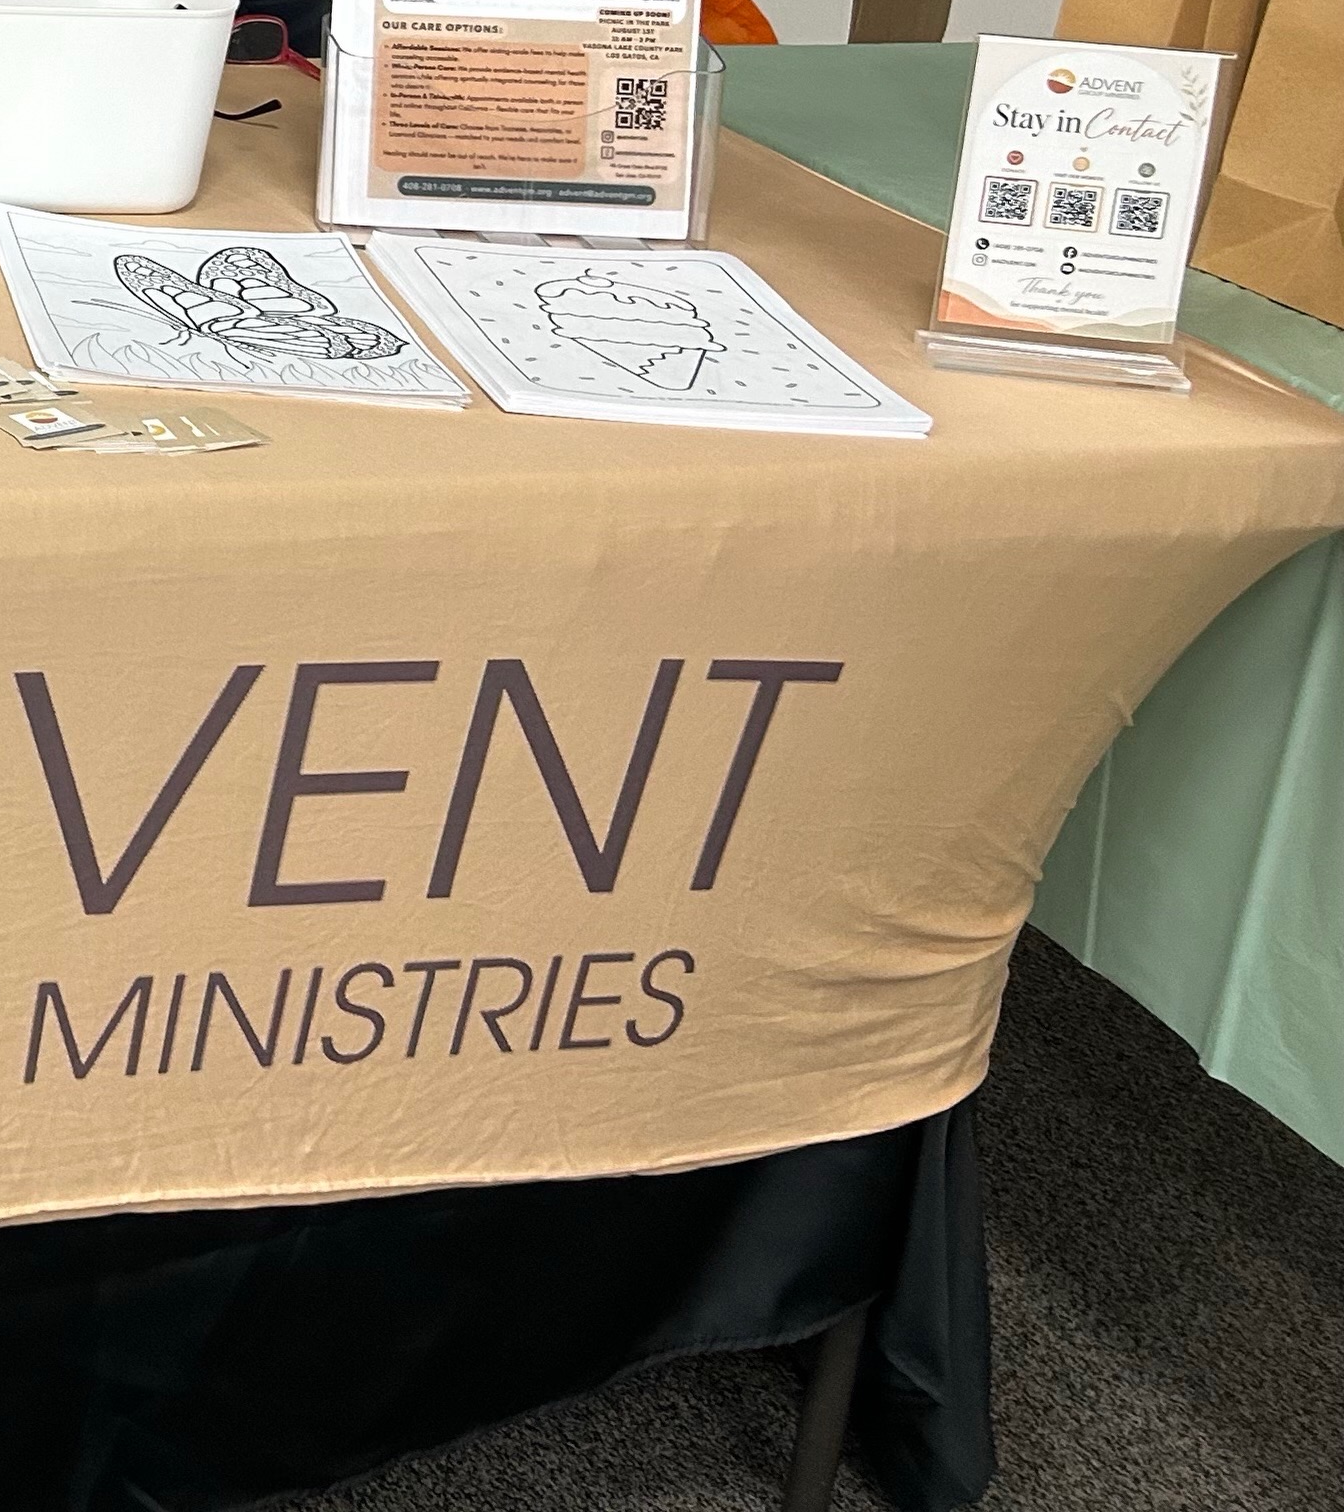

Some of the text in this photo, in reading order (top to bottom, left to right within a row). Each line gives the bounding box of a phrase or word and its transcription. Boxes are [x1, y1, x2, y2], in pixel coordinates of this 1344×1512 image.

[382, 20, 504, 34] OUR CARE OPTIONS:
[1079, 77, 1144, 94] ADVENT
[993, 103, 1189, 147] Stay in Contact
[1018, 277, 1104, 305] Thank you
[24, 948, 698, 1084] MINISTRIES
